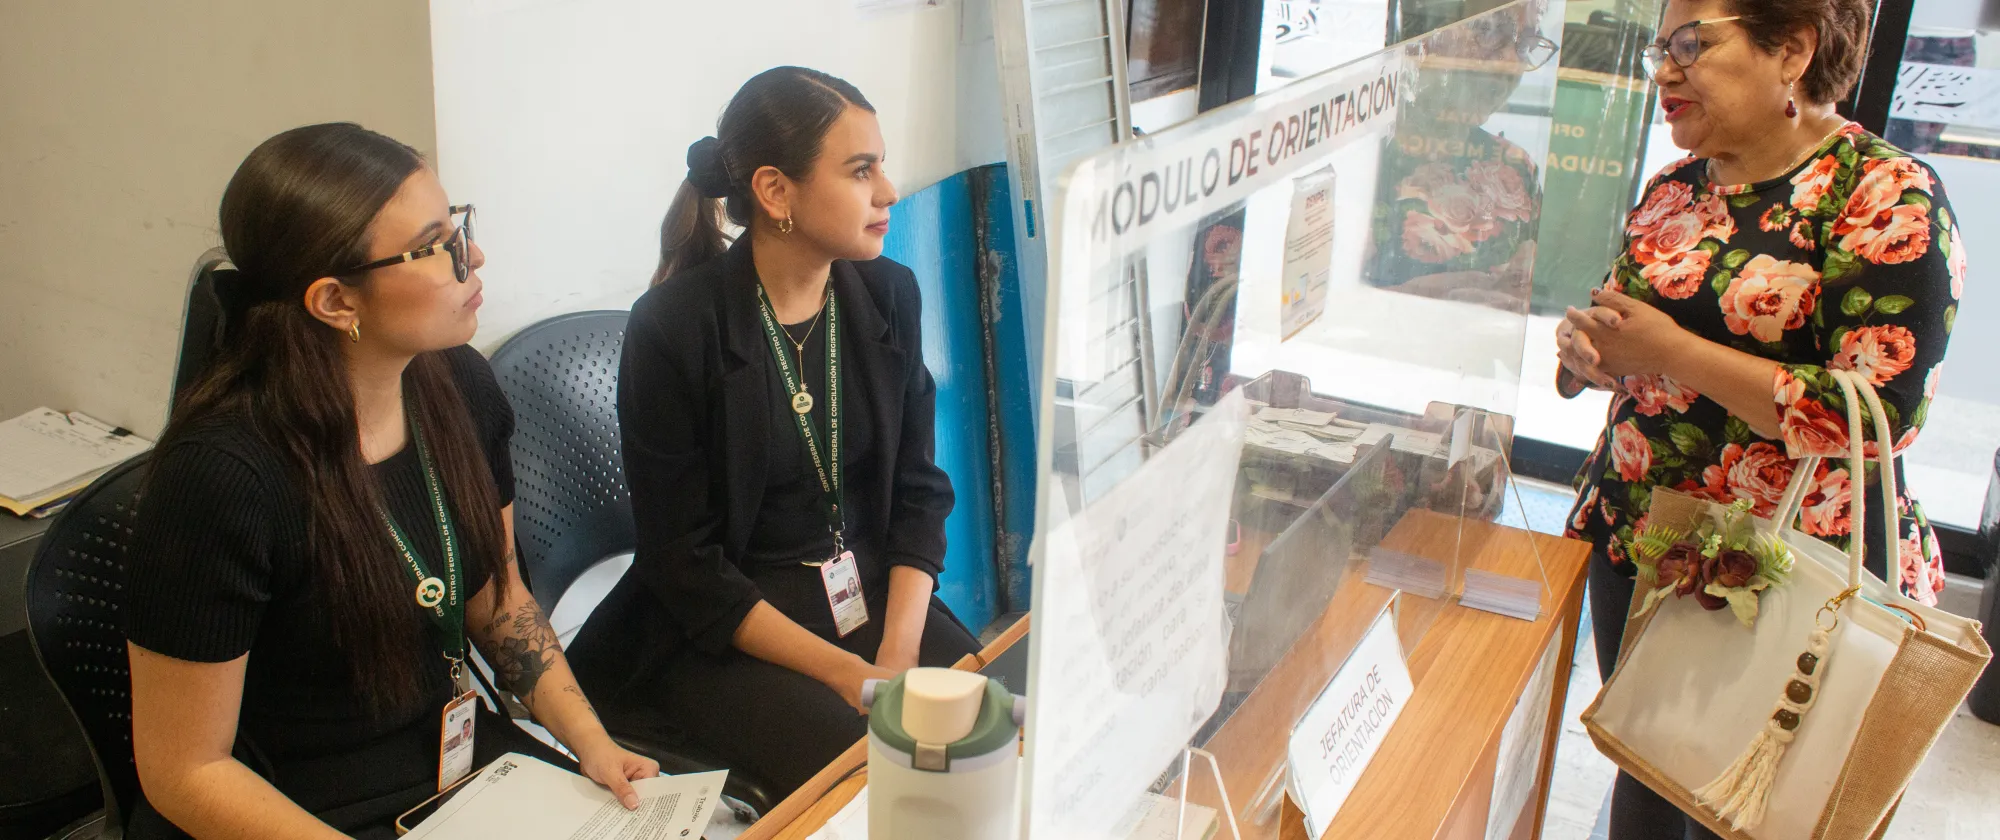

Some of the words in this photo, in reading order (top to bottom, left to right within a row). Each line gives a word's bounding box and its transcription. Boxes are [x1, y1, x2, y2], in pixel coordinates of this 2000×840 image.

[1091, 147, 1221, 241] MÓDULO
[1227, 130, 1263, 187] DE
[1266, 66, 1398, 167] ORIENTACIÓN
[760, 301, 775, 336] LABORAL
[829, 287, 837, 319] LABORAL
[772, 335, 789, 371] REGISTRO
[829, 323, 837, 358] REGISTRO
[784, 369, 791, 378] Y
[829, 368, 838, 417] CONCILIACIÓN
[803, 426, 812, 438] DE
[831, 417, 838, 429] DE
[808, 437, 822, 468] FEDERAL
[817, 467, 831, 493] CENTRO
[442, 524, 450, 536] DE
[403, 550, 415, 563] DE
[446, 535, 456, 572] FEDERAL
[411, 560, 426, 581] ERAL
[434, 603, 445, 618] CEN
[1320, 685, 1369, 760] JEFATURA
[1366, 664, 1382, 693] DE
[1329, 687, 1394, 786] ORIENTACIÓN
